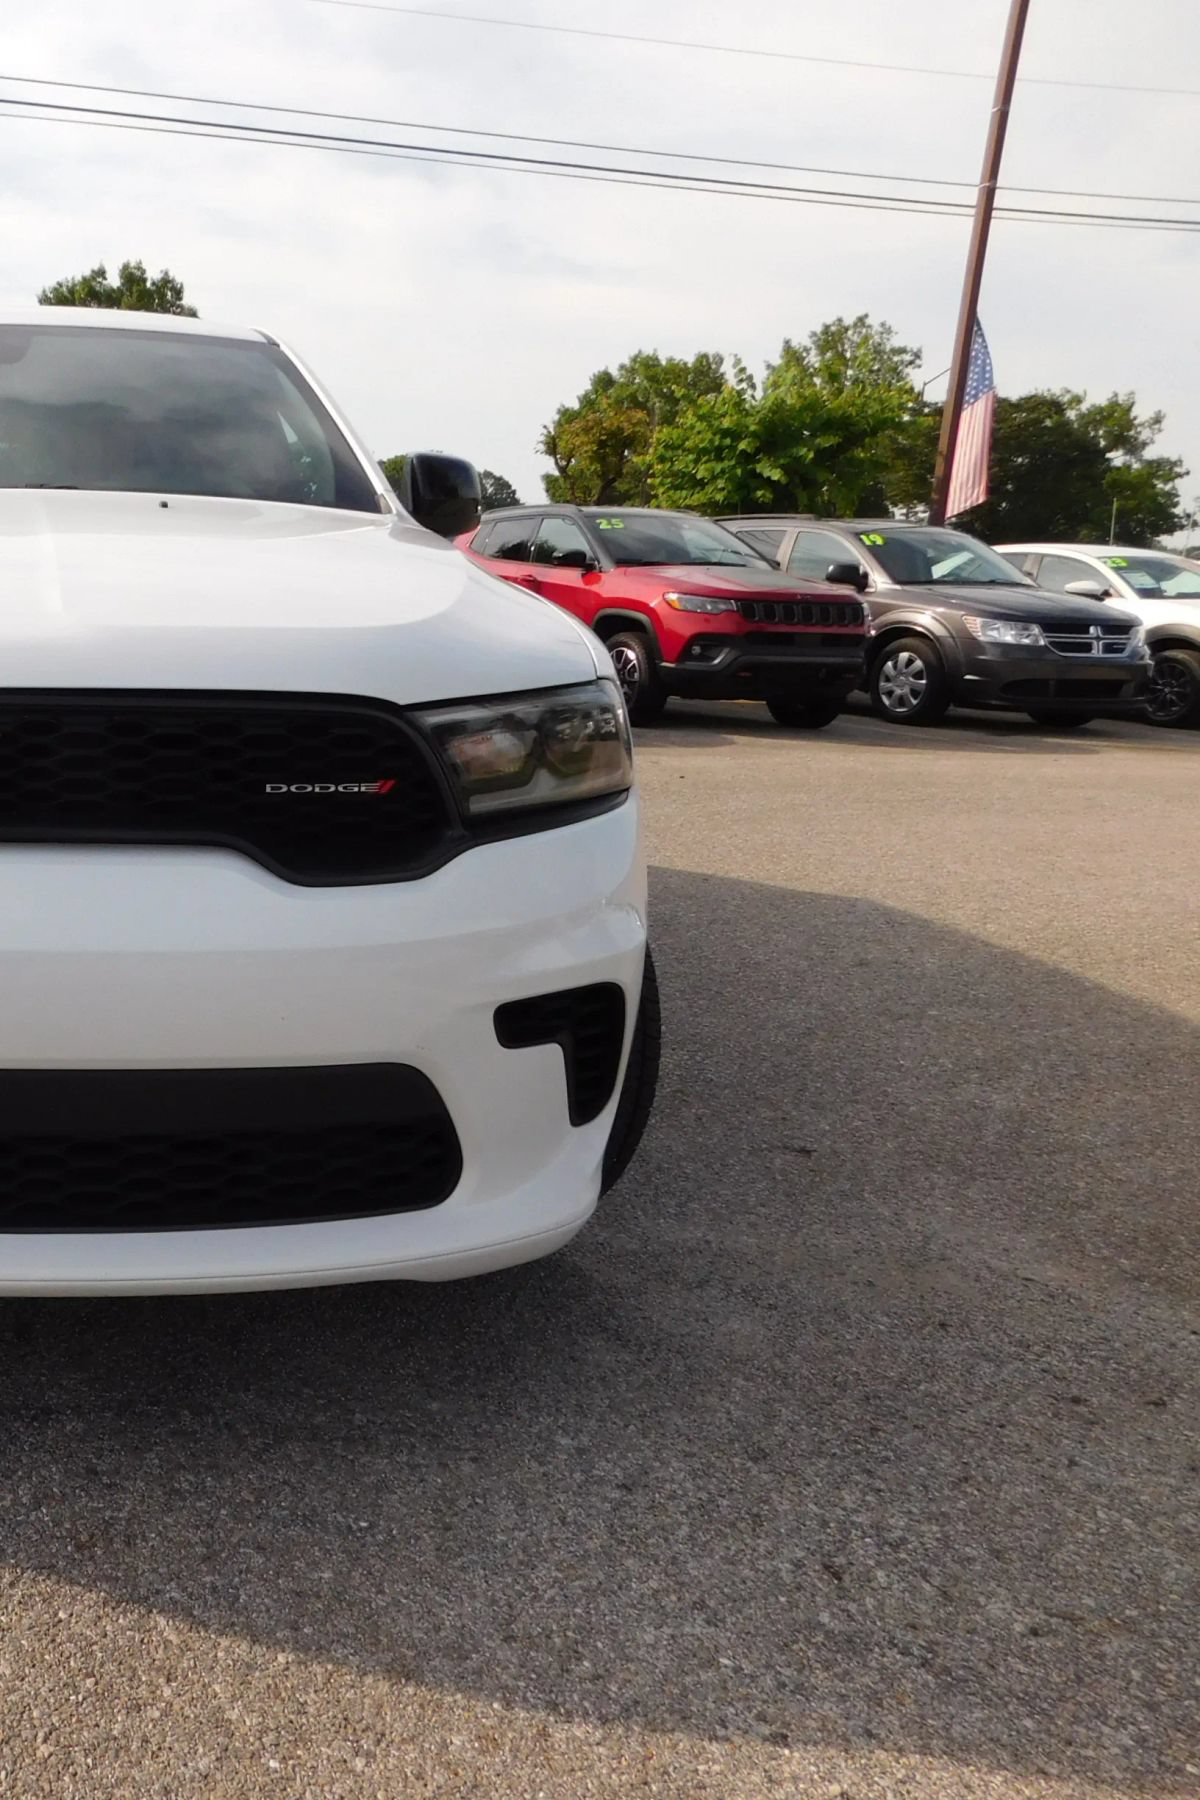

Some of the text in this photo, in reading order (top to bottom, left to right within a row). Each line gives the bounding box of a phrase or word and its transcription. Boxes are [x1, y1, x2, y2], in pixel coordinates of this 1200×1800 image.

[595, 518, 625, 529] 25
[860, 534, 884, 546] 19
[265, 782, 381, 793] DODGE
